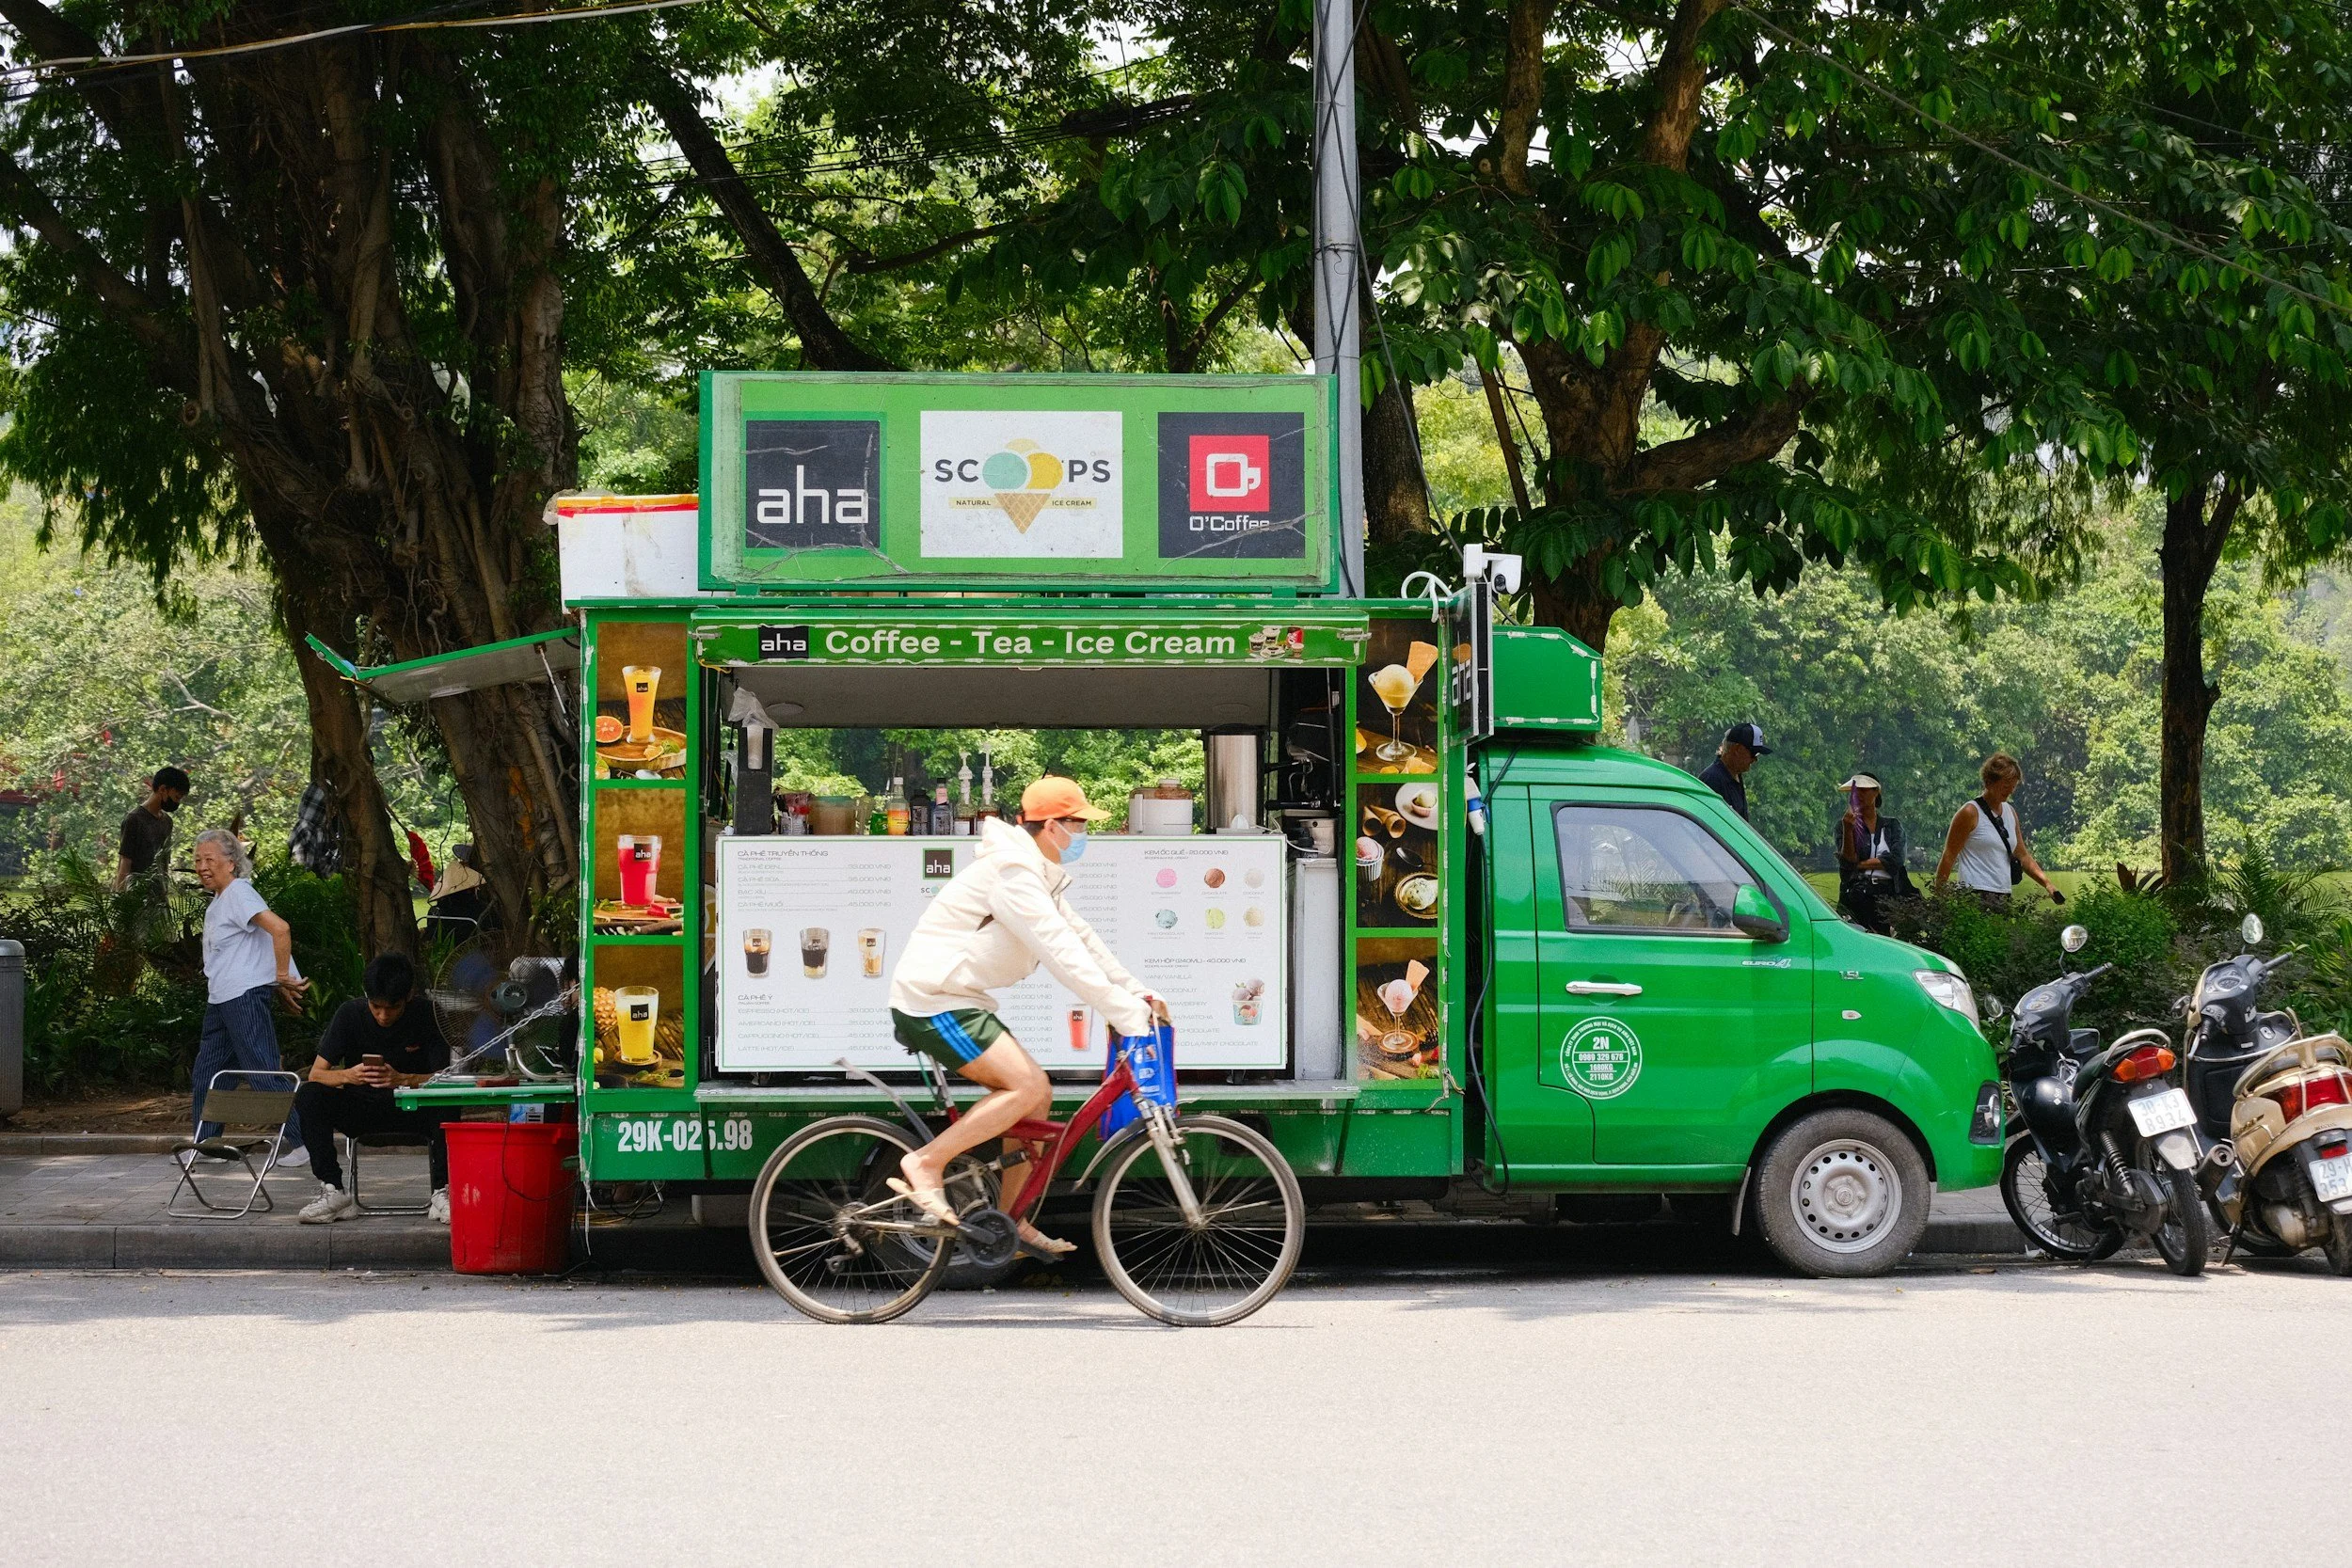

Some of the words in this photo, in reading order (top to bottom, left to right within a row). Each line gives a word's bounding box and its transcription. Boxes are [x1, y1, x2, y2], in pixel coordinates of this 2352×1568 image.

[757, 464, 869, 524] aha
[1189, 515, 1270, 531] O'Coffee
[761, 632, 807, 653] aha
[825, 628, 940, 655] Coffee
[971, 629, 1034, 655] Tea
[1065, 629, 1117, 655] Ice
[1124, 629, 1235, 655] Cream
[635, 849, 652, 859] aha
[926, 859, 951, 873] aha
[632, 1010, 648, 1019] aha
[1592, 1036, 1610, 1050] 2N
[2145, 1110, 2186, 1132] 8934
[2319, 1158, 2352, 1179] 29-H
[2320, 1178, 2352, 1196] 353
